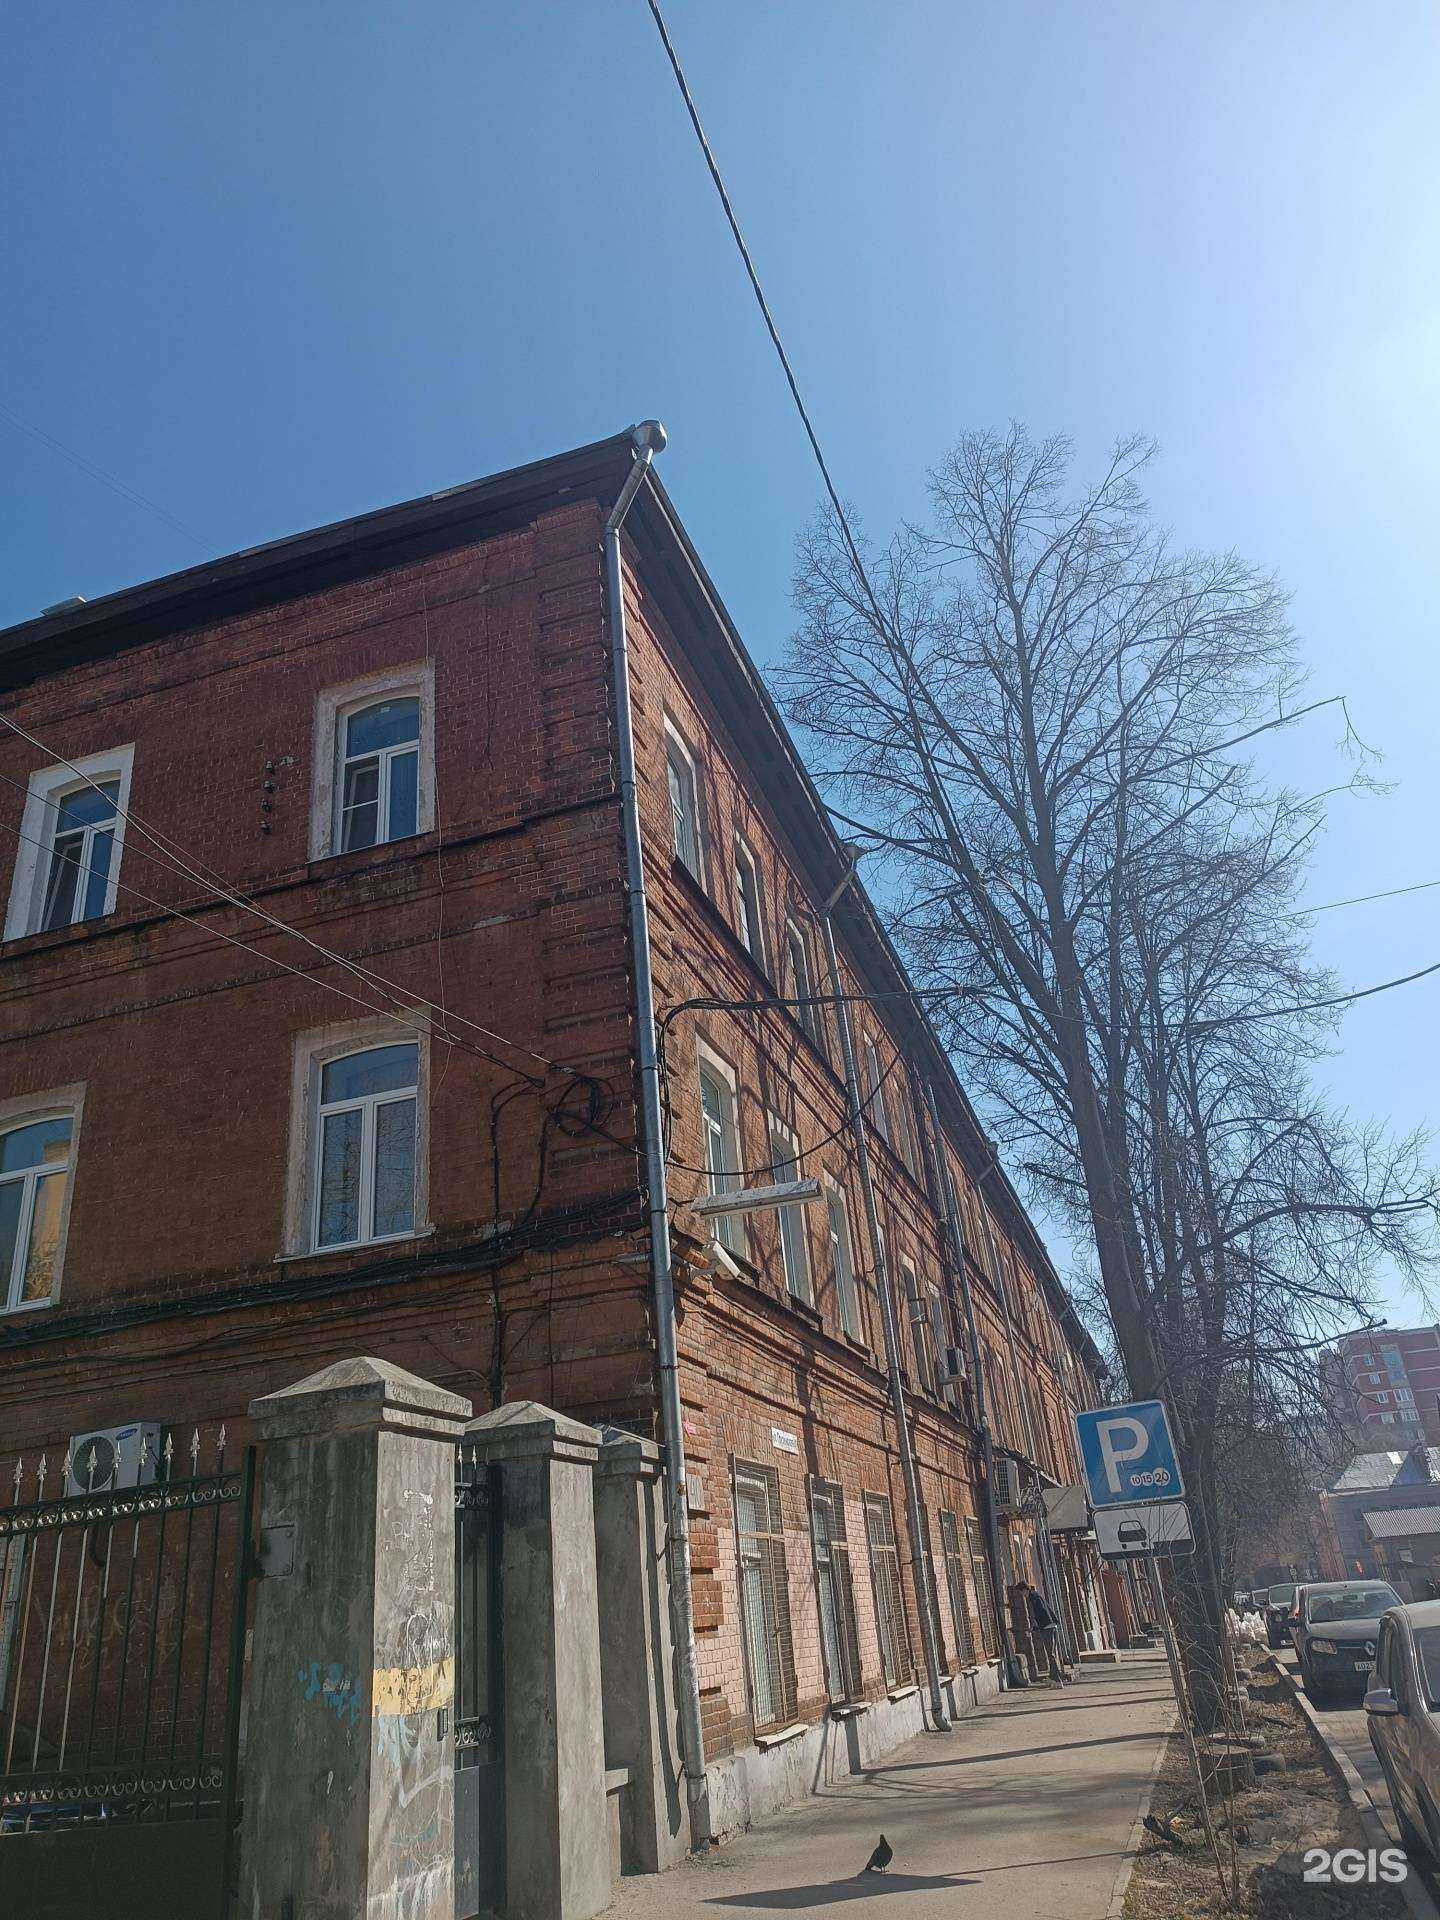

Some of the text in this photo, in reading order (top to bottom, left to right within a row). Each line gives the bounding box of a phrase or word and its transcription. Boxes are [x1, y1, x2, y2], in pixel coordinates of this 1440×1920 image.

[1096, 1417, 1149, 1493] P
[1131, 1471, 1169, 1485] 10 15 20
